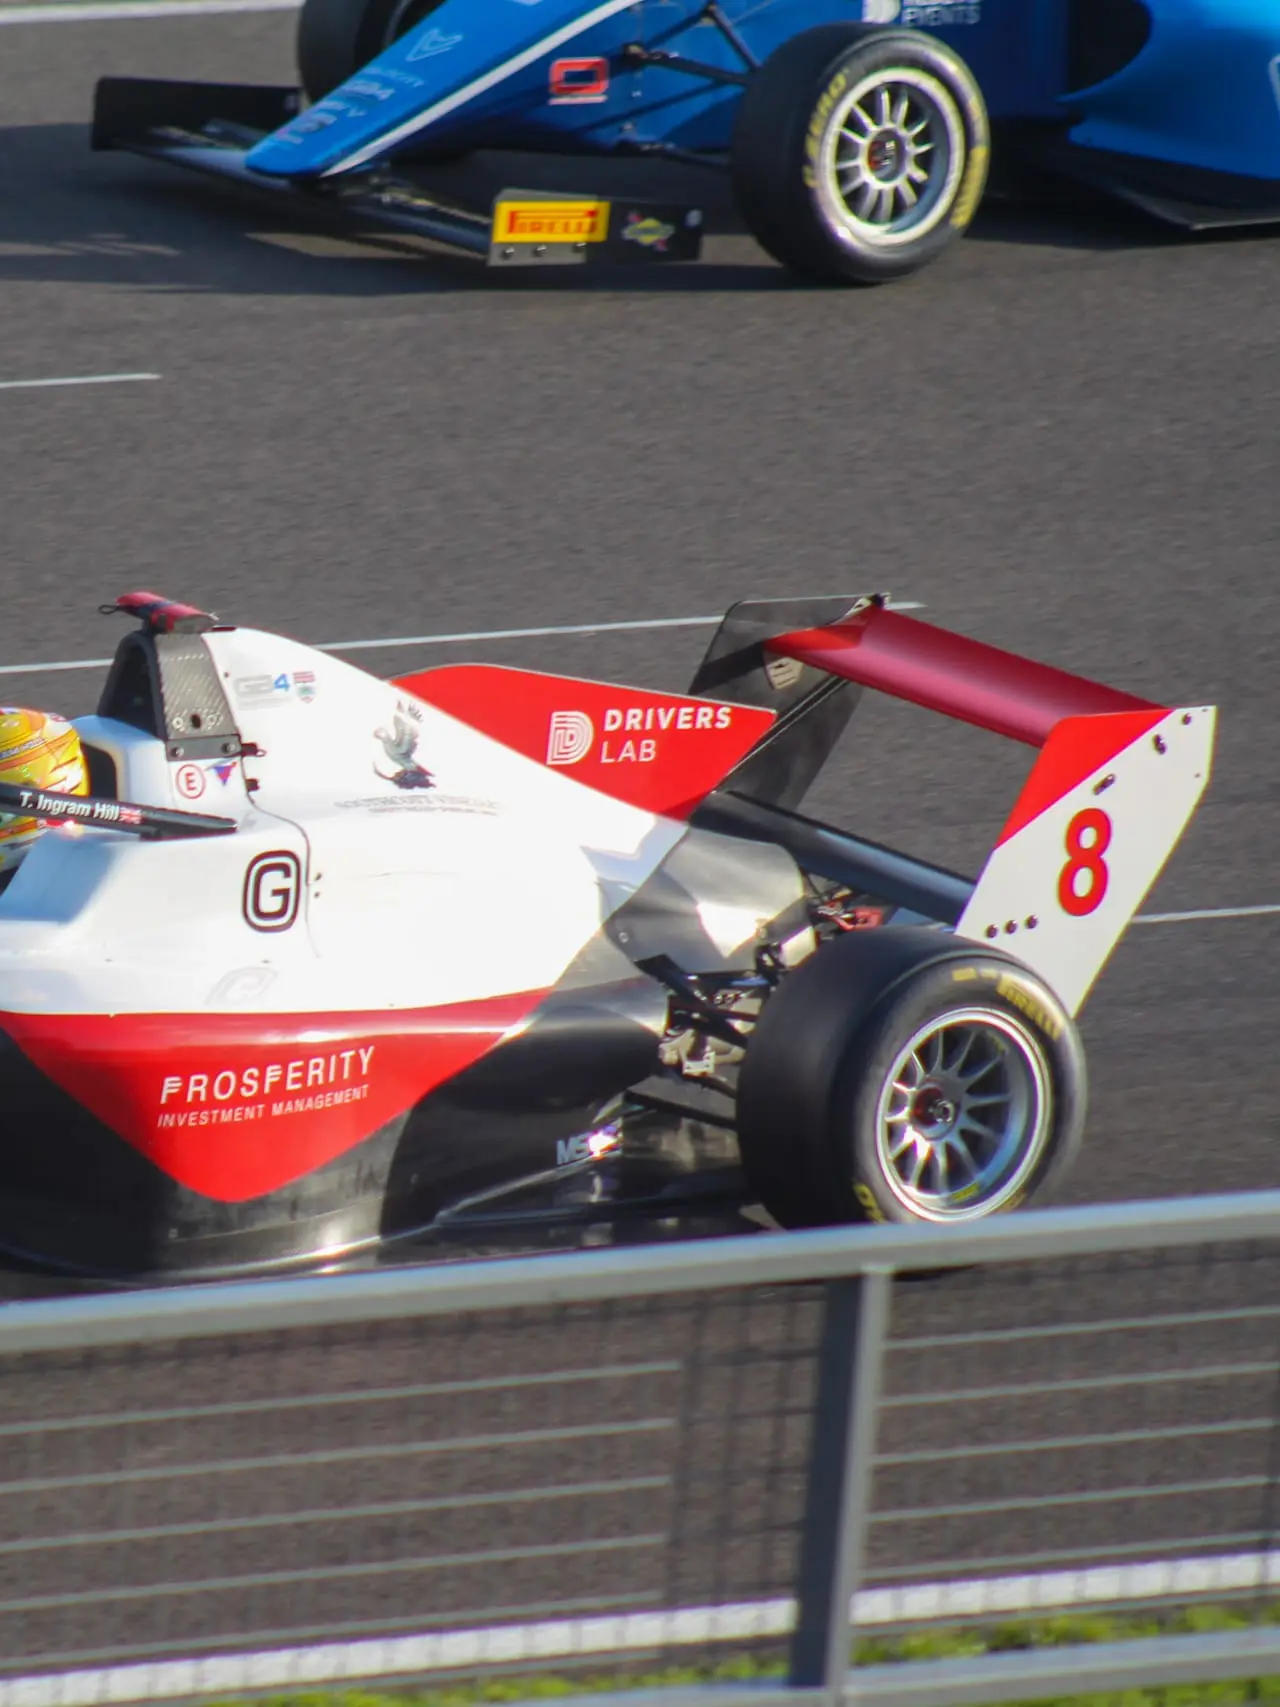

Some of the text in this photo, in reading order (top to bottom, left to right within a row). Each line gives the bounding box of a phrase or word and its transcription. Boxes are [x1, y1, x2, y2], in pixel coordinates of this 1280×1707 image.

[507, 209, 599, 235] PIRELLI
[604, 706, 732, 732] DRIVERS
[600, 739, 657, 764] LAB
[20, 791, 120, 821] T. Ingram Hill
[1058, 807, 1112, 917] 8
[160, 1046, 375, 1105] PROSPERITY
[157, 1084, 370, 1129] INVESTMENT MANAGEMENT
